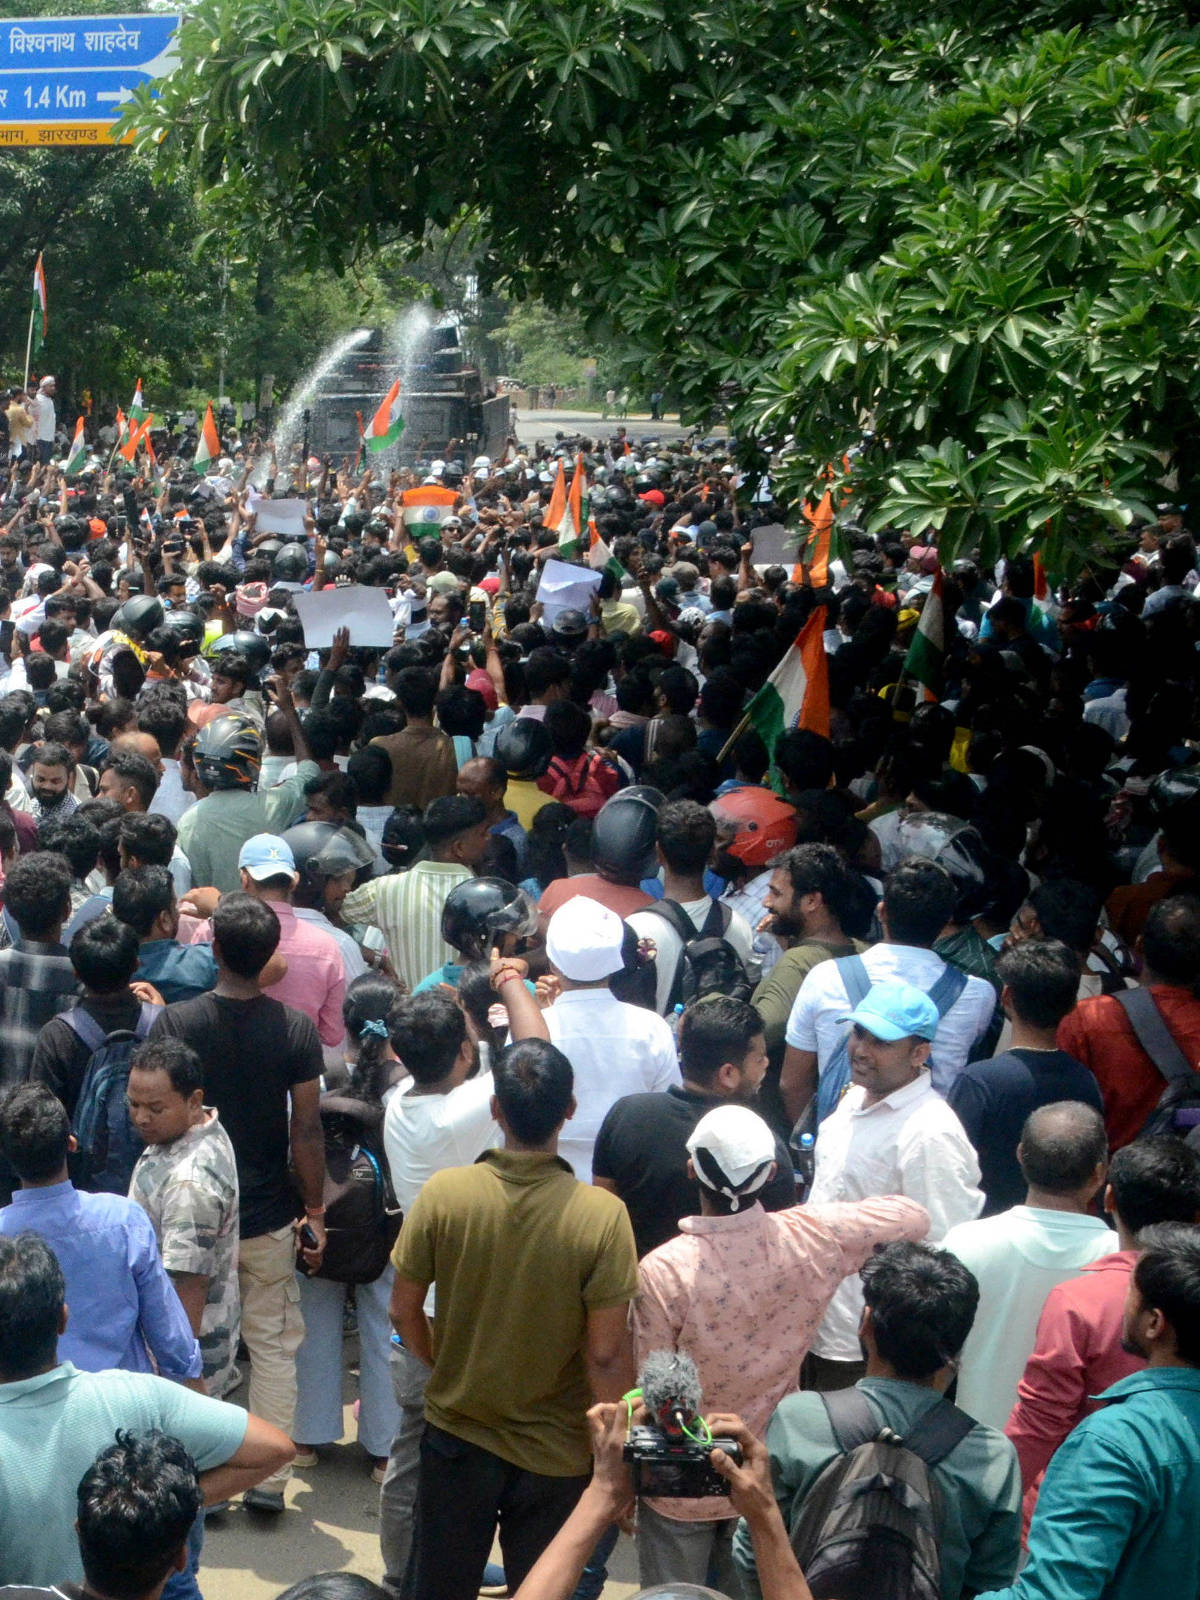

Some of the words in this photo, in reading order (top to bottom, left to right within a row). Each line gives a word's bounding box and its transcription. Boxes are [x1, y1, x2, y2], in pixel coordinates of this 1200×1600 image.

[9, 27, 75, 54] विश्वनाथ
[84, 23, 141, 52] शाहदेव
[23, 85, 50, 108] 1.4
[55, 85, 87, 108] Km
[39, 128, 98, 142] झारखण्ड
